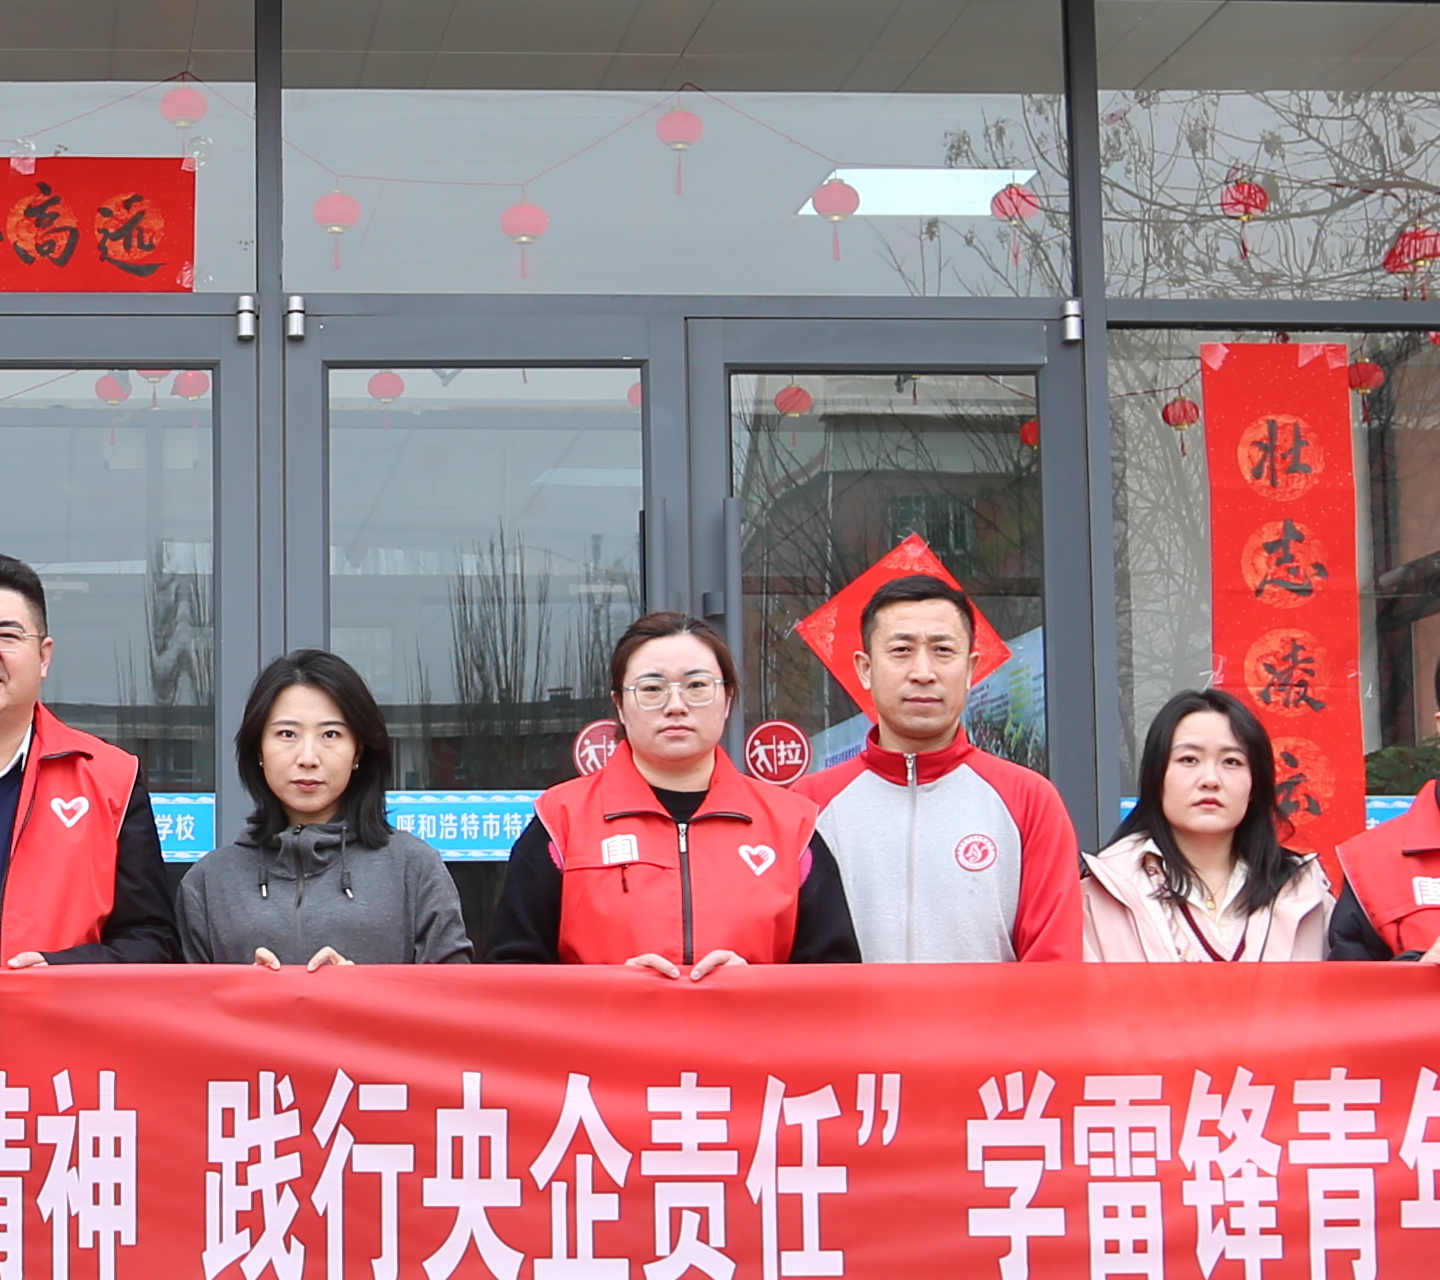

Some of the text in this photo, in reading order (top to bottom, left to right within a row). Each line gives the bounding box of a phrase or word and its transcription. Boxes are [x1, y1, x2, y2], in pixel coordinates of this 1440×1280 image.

[1250, 419, 1328, 818] 壮志凌云
[777, 740, 803, 766] 拉
